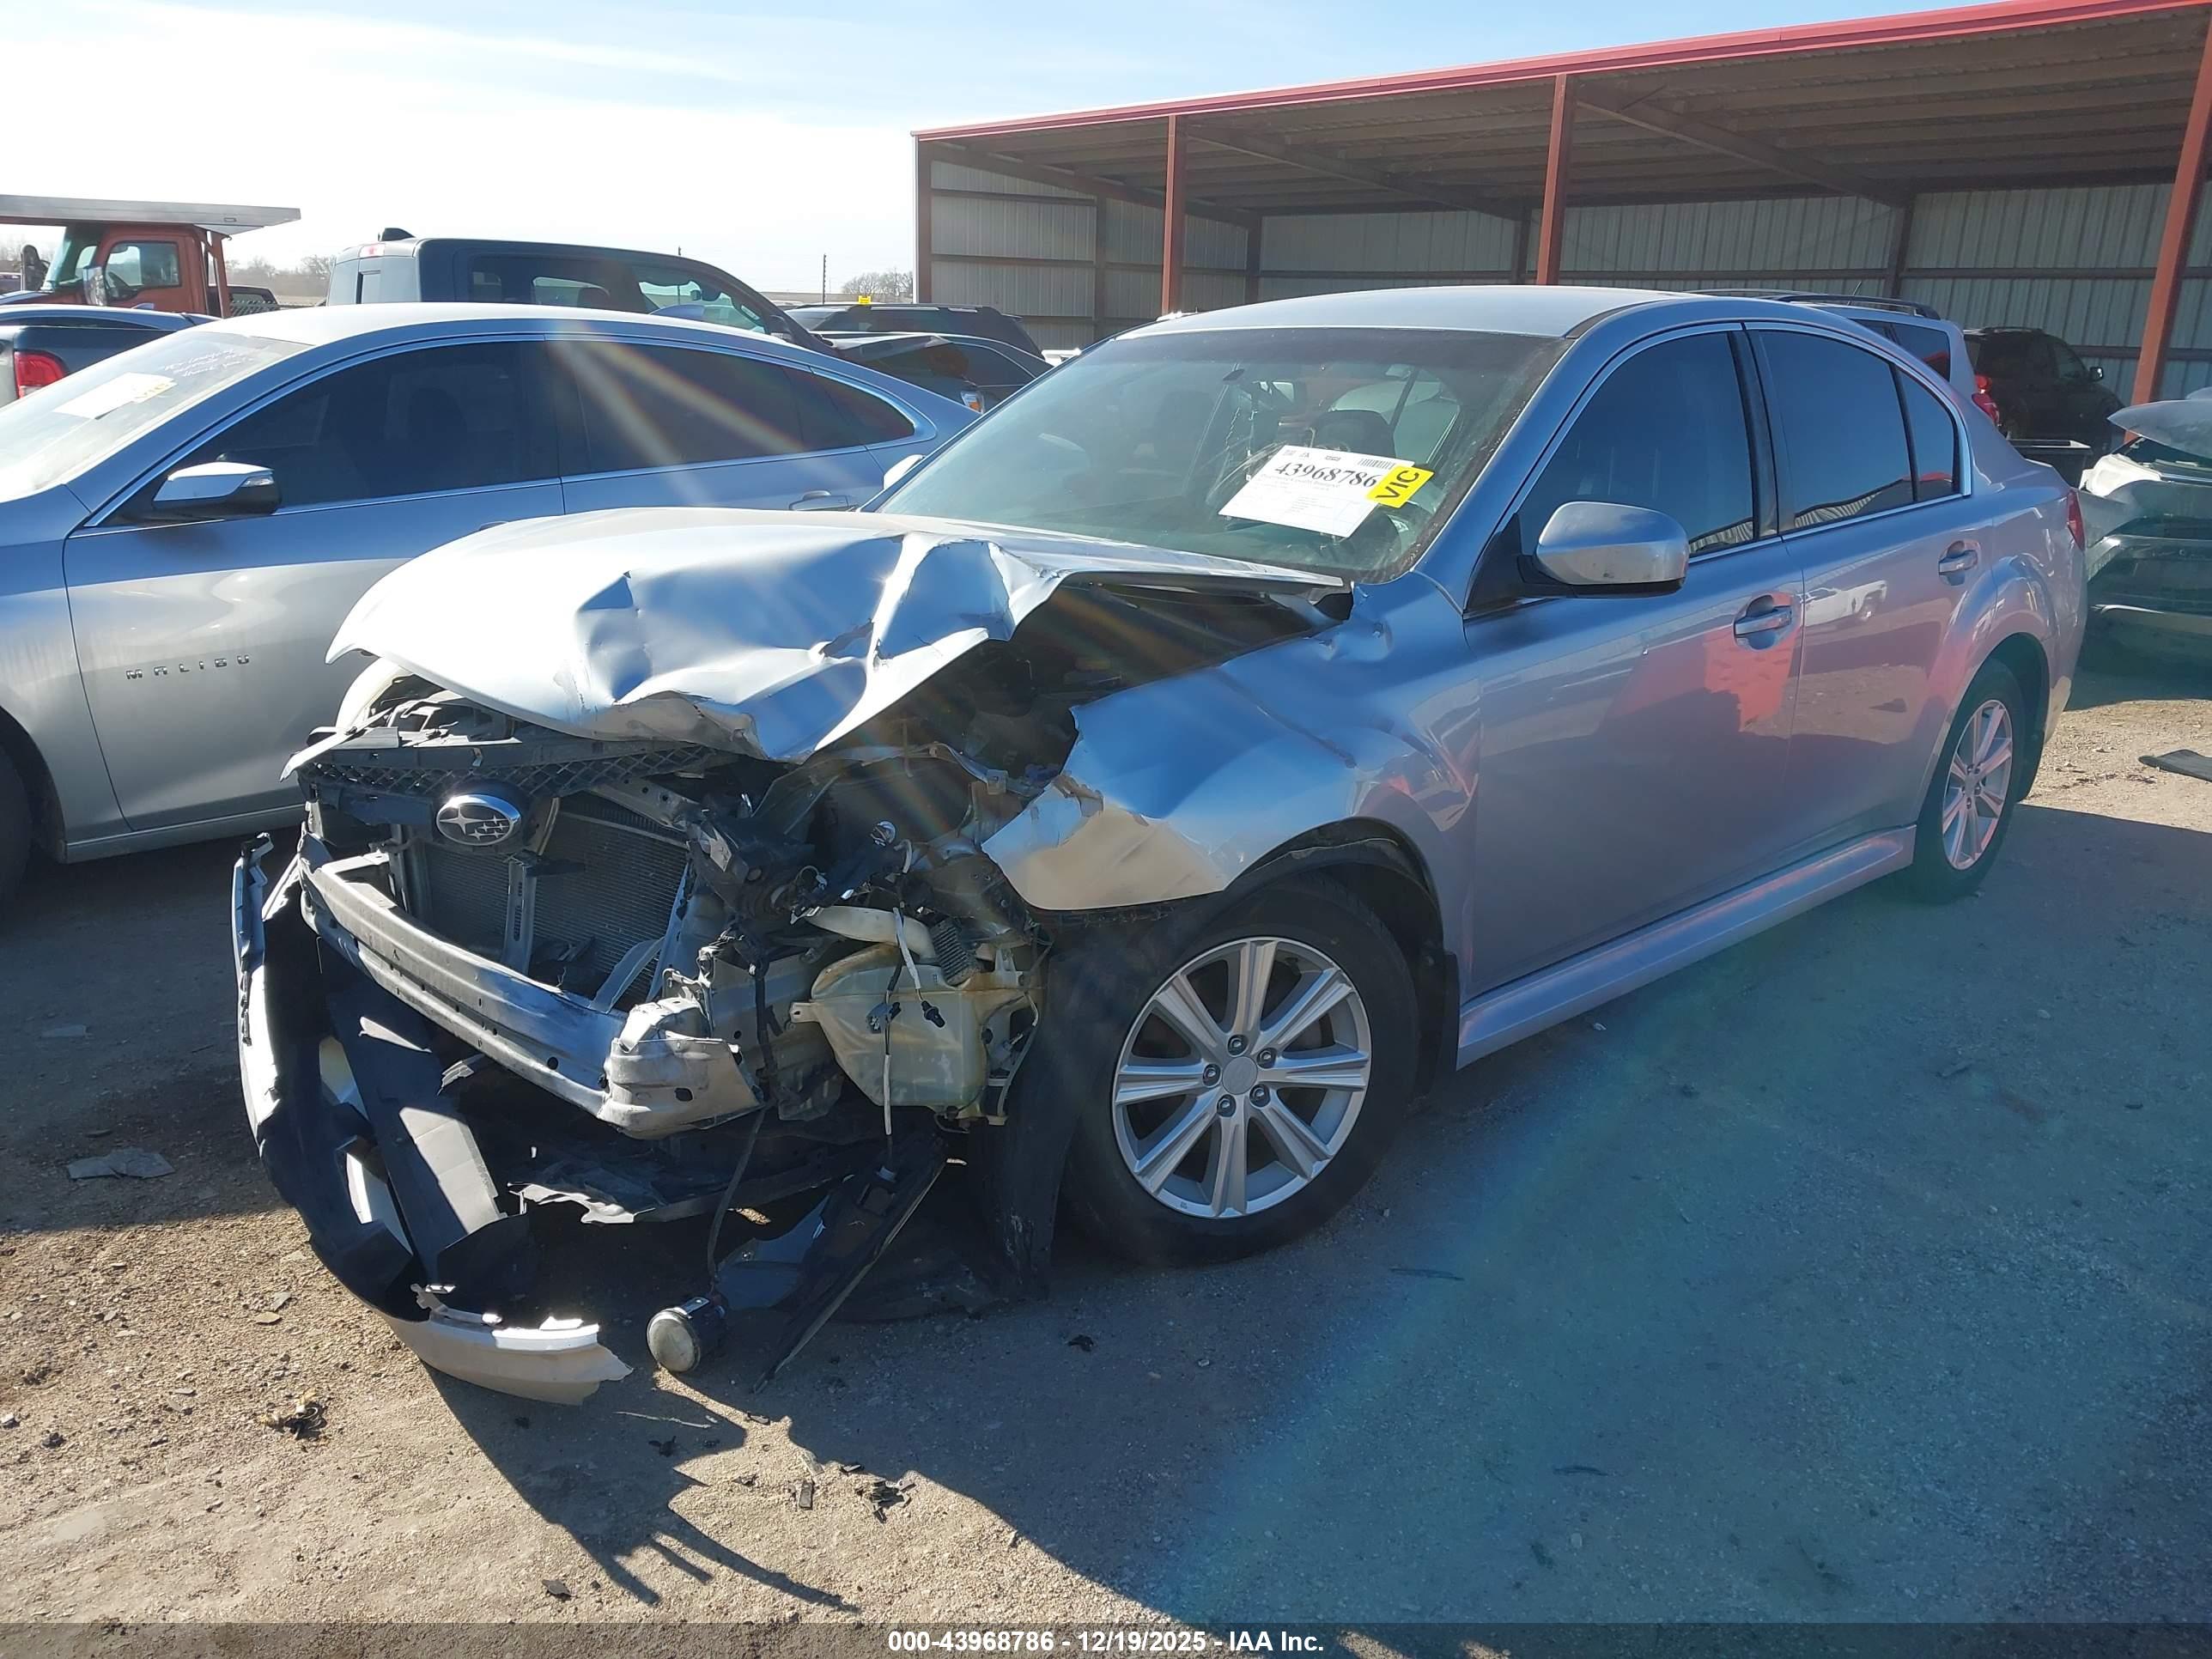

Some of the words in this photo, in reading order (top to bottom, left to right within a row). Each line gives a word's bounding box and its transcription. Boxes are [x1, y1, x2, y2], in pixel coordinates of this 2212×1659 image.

[1274, 462, 1382, 488] 43968786
[1375, 470, 1420, 500] VIC
[125, 654, 250, 680] MALIBU
